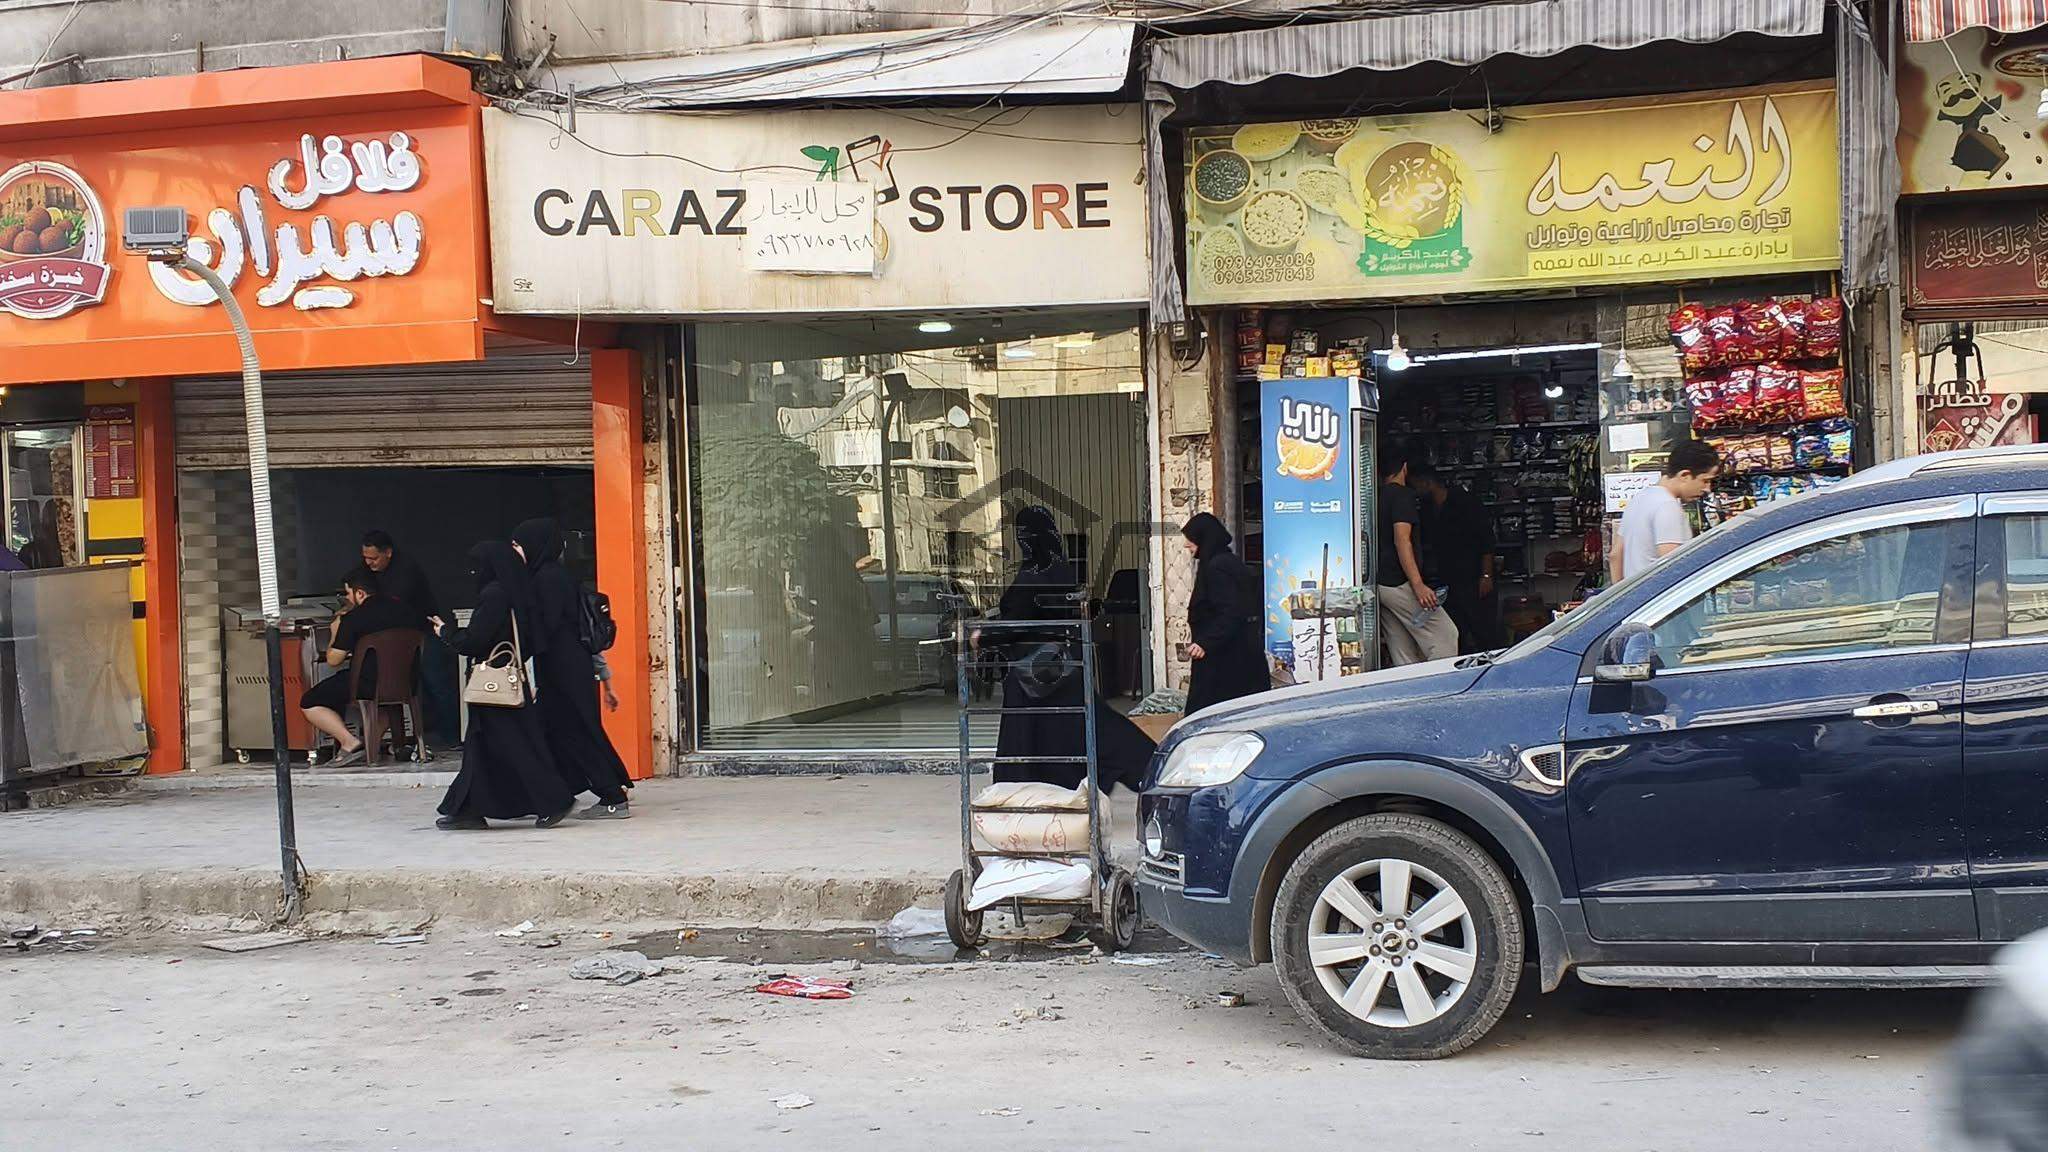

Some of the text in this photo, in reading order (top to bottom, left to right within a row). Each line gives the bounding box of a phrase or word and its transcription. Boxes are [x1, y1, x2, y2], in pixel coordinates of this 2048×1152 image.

[267, 131, 420, 210] فلافل
[1526, 95, 1792, 216] النعمه
[533, 181, 1111, 237] CARAZ STORE
[820, 183, 866, 224] محل
[147, 184, 422, 311] سيران
[1527, 206, 1791, 249] تجارة محاصيل زراعية وتوابل
[1214, 267, 1315, 285] 0965257843
[1533, 254, 1574, 271] نعمه
[1578, 252, 1603, 268] الله
[1607, 254, 1633, 269] عبد
[1638, 245, 1699, 268] الكريم
[0, 265, 84, 291] خبزة سخن
[1280, 396, 1340, 448] راني
